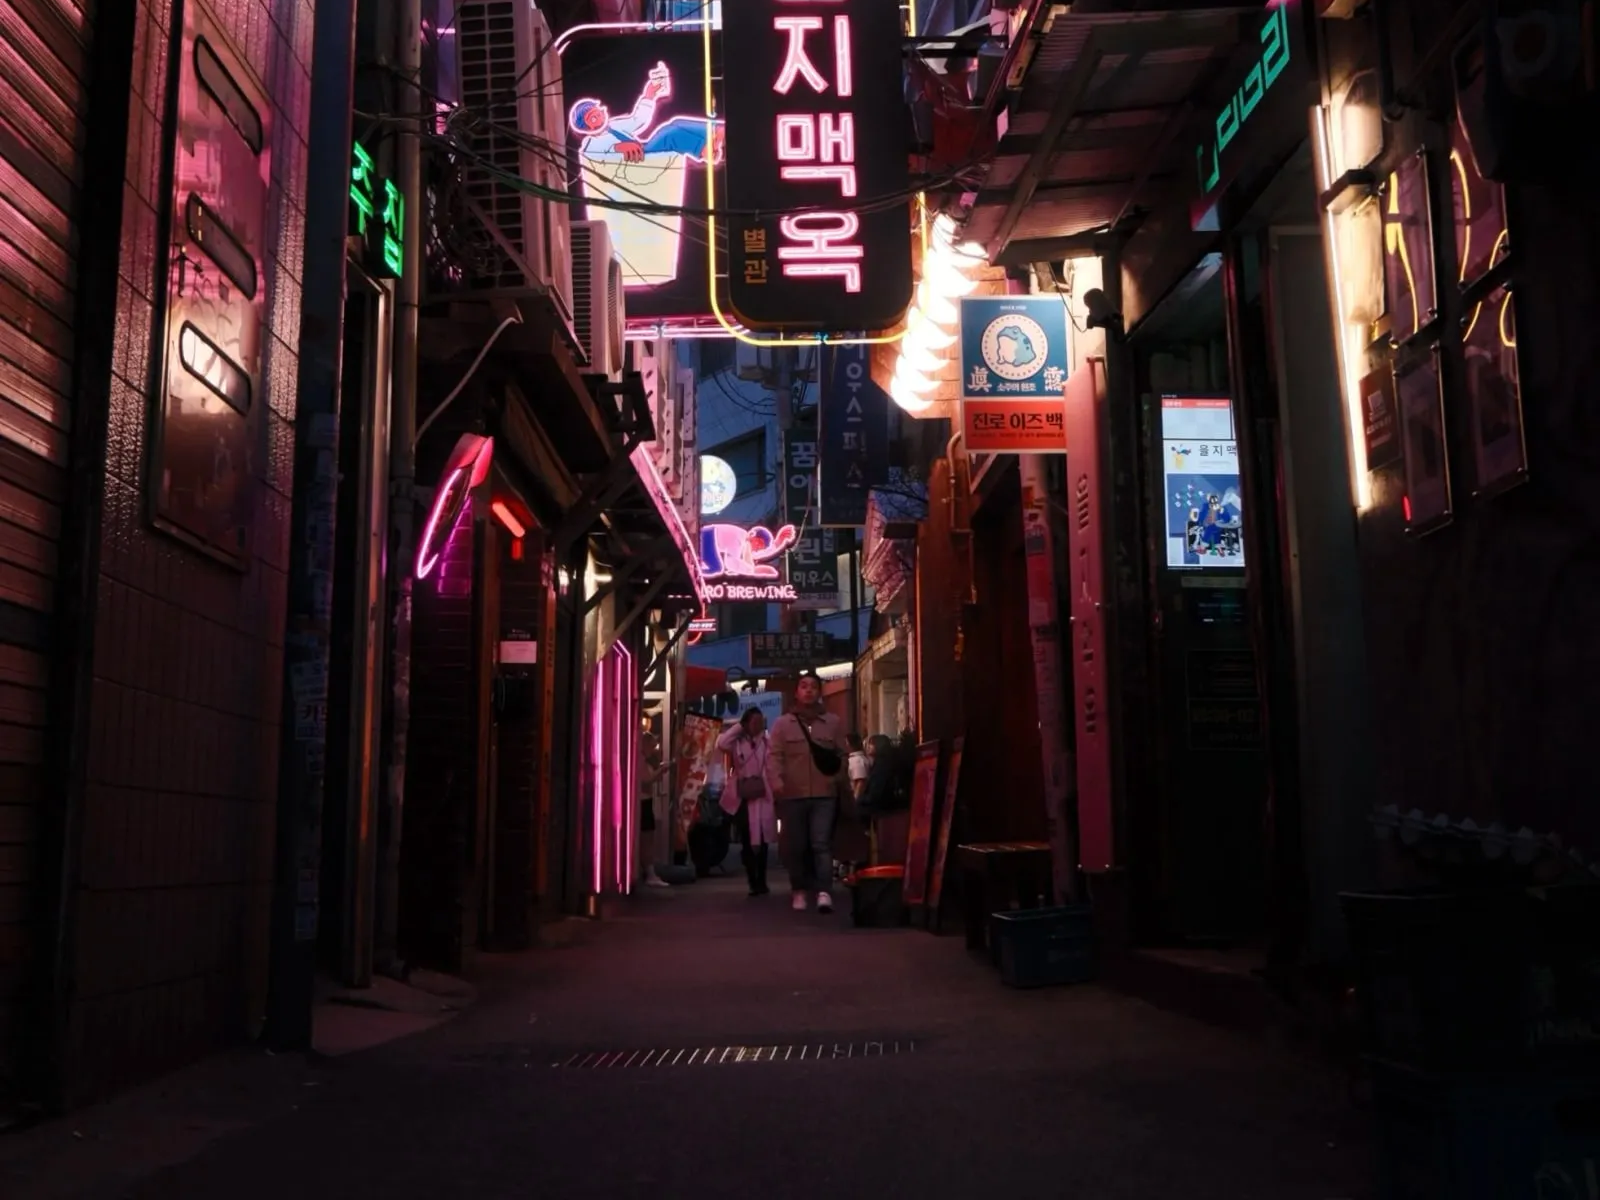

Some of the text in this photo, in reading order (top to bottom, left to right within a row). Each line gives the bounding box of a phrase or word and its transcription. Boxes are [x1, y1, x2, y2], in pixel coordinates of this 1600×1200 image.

[973, 412, 1064, 430] 진로 이즈 백
[726, 584, 798, 599] BREWING
